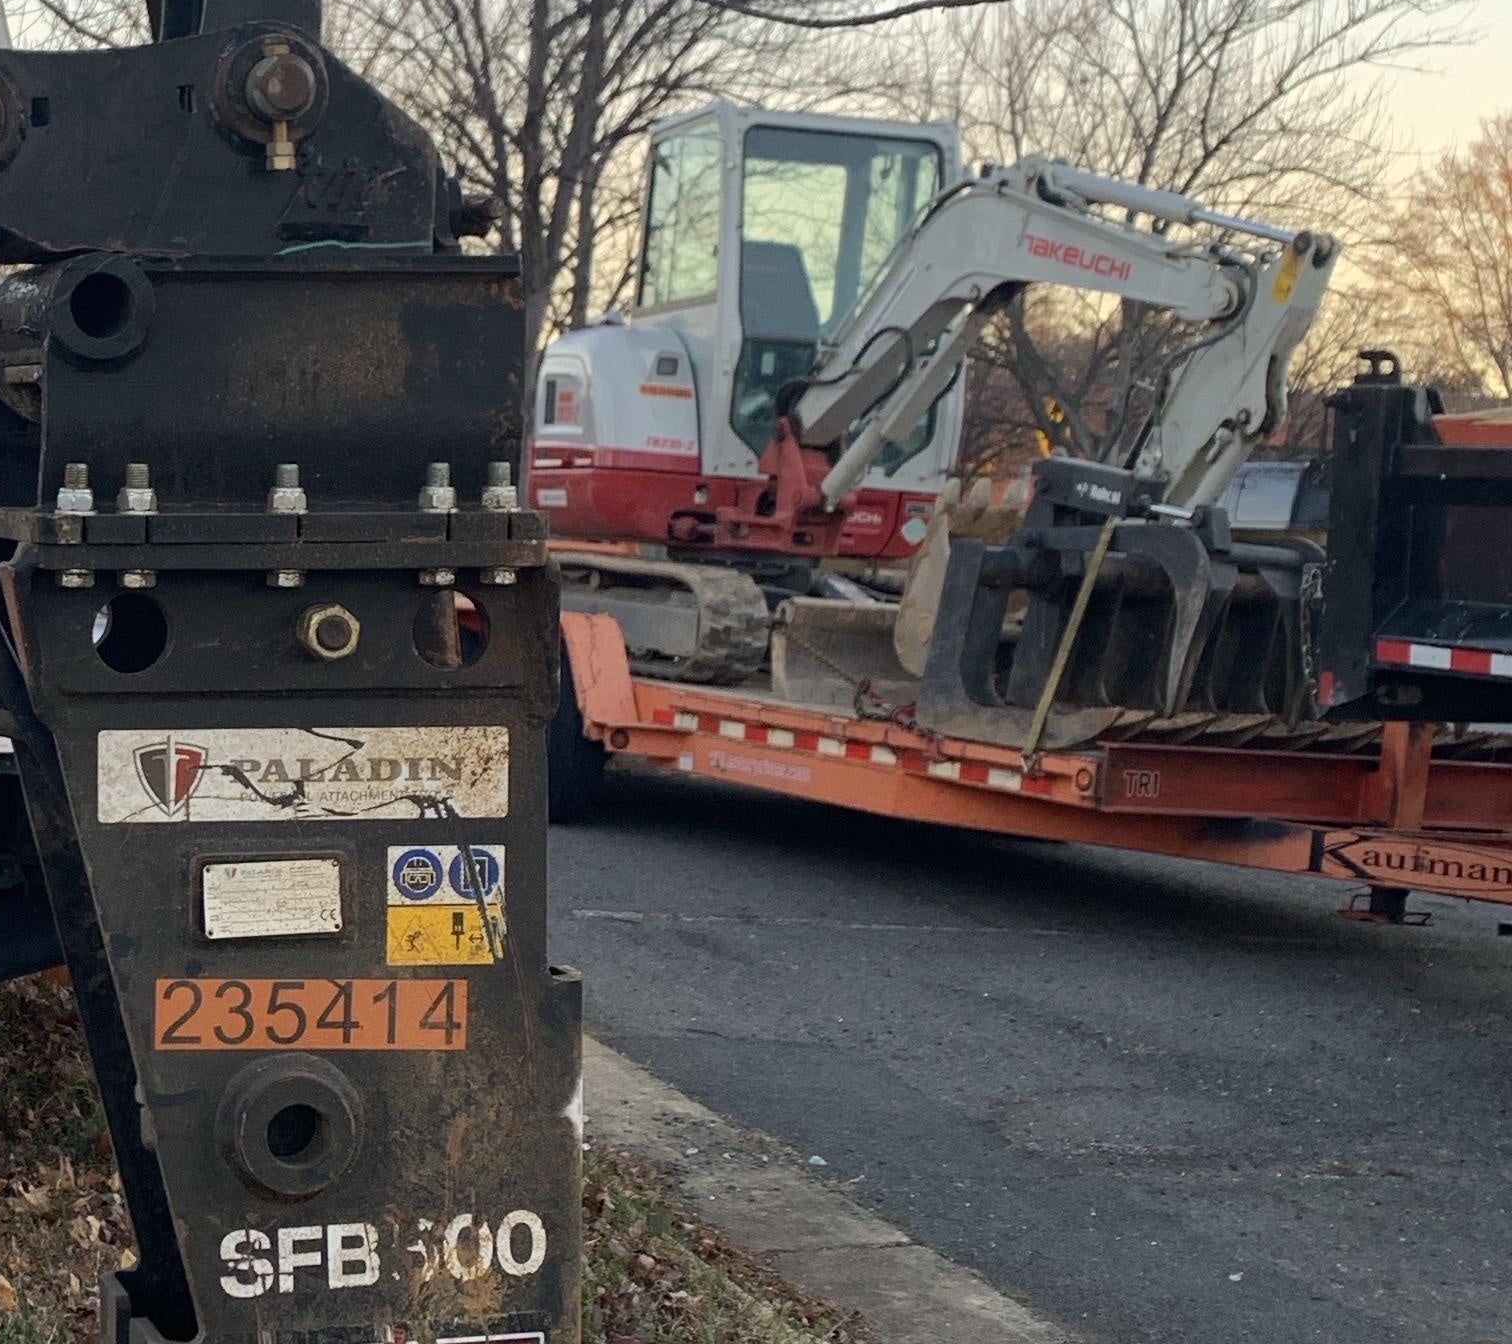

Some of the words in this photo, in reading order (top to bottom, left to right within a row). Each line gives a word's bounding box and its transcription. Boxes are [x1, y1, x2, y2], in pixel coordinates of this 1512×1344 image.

[230, 757, 466, 784] PALADIN
[1124, 769, 1161, 798] TRI
[160, 979, 462, 1045] 235414
